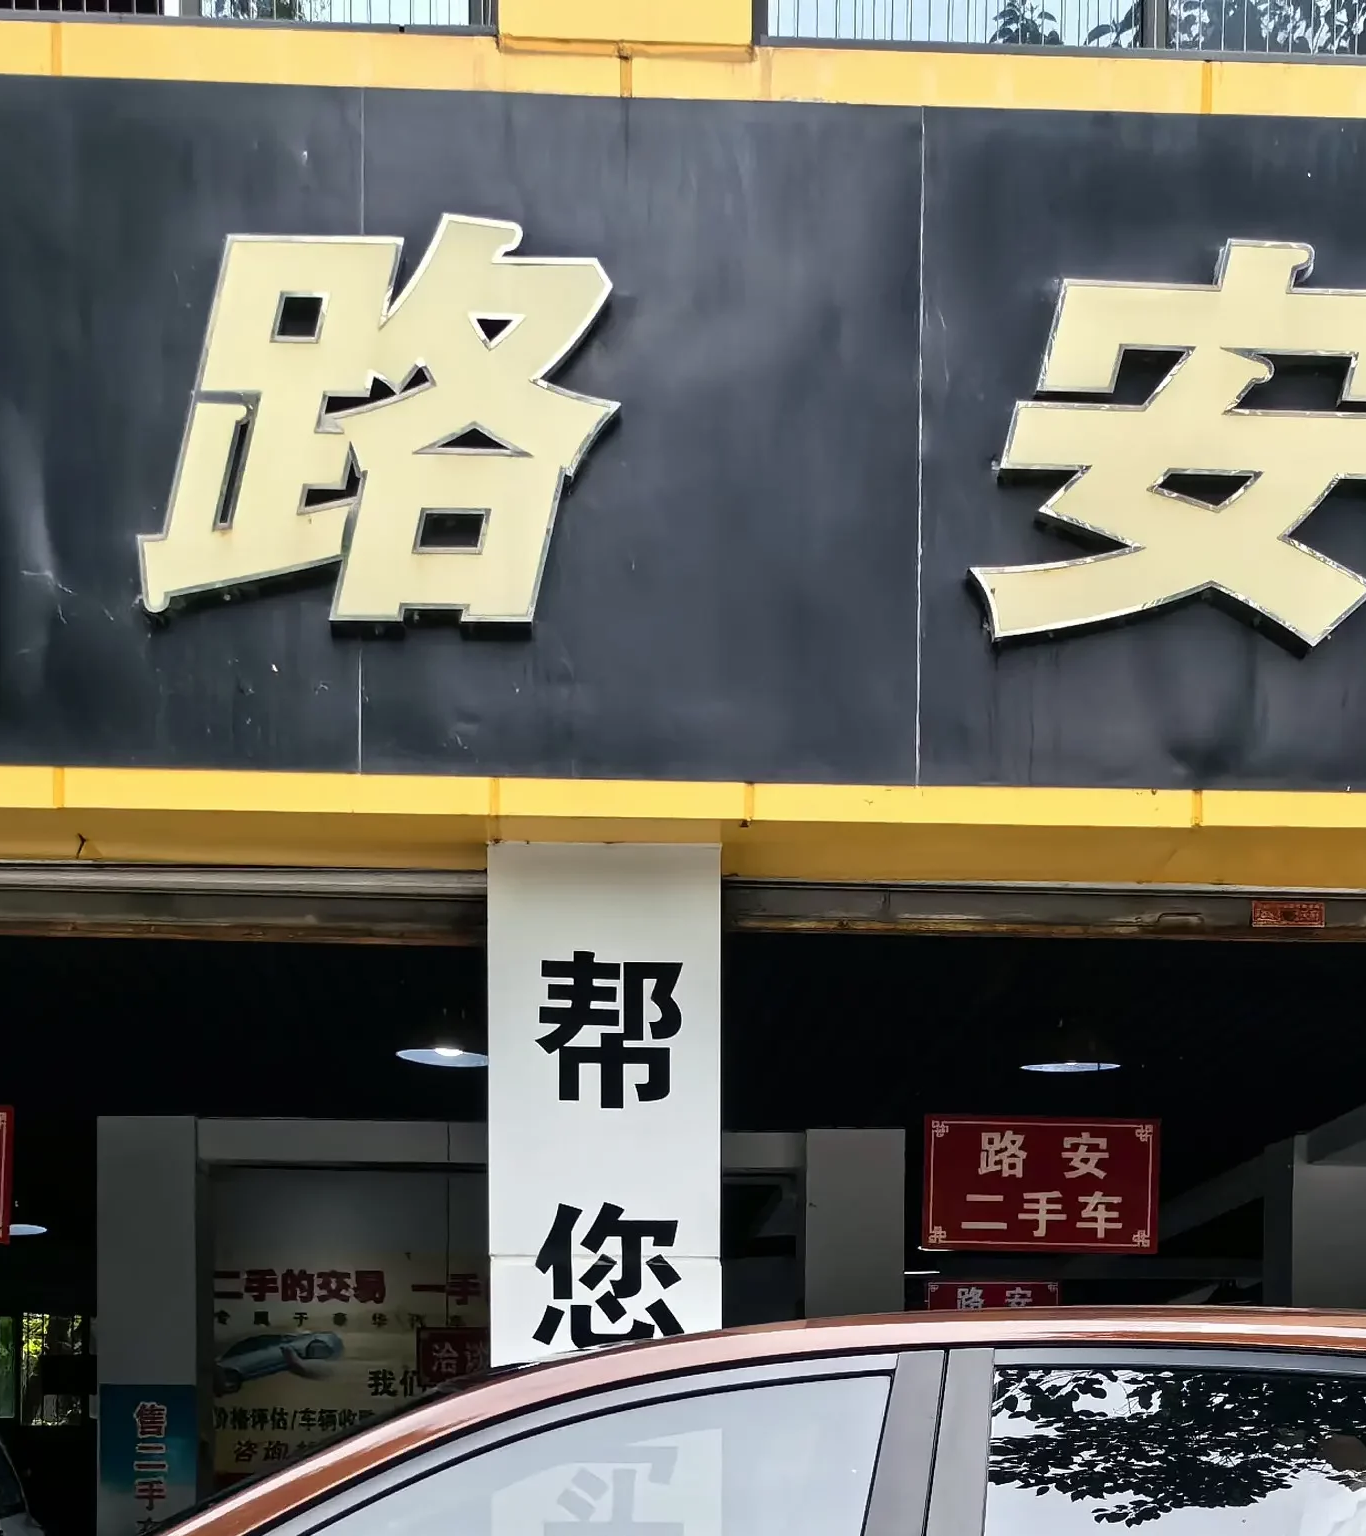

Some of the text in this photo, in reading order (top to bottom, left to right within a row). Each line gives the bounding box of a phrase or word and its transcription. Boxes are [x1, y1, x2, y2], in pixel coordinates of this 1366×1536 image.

[978, 1130, 1110, 1180] 路安
[960, 1190, 1123, 1239] 二手车
[212, 1268, 387, 1305] 二手的交易
[956, 1286, 1033, 1311] 路安
